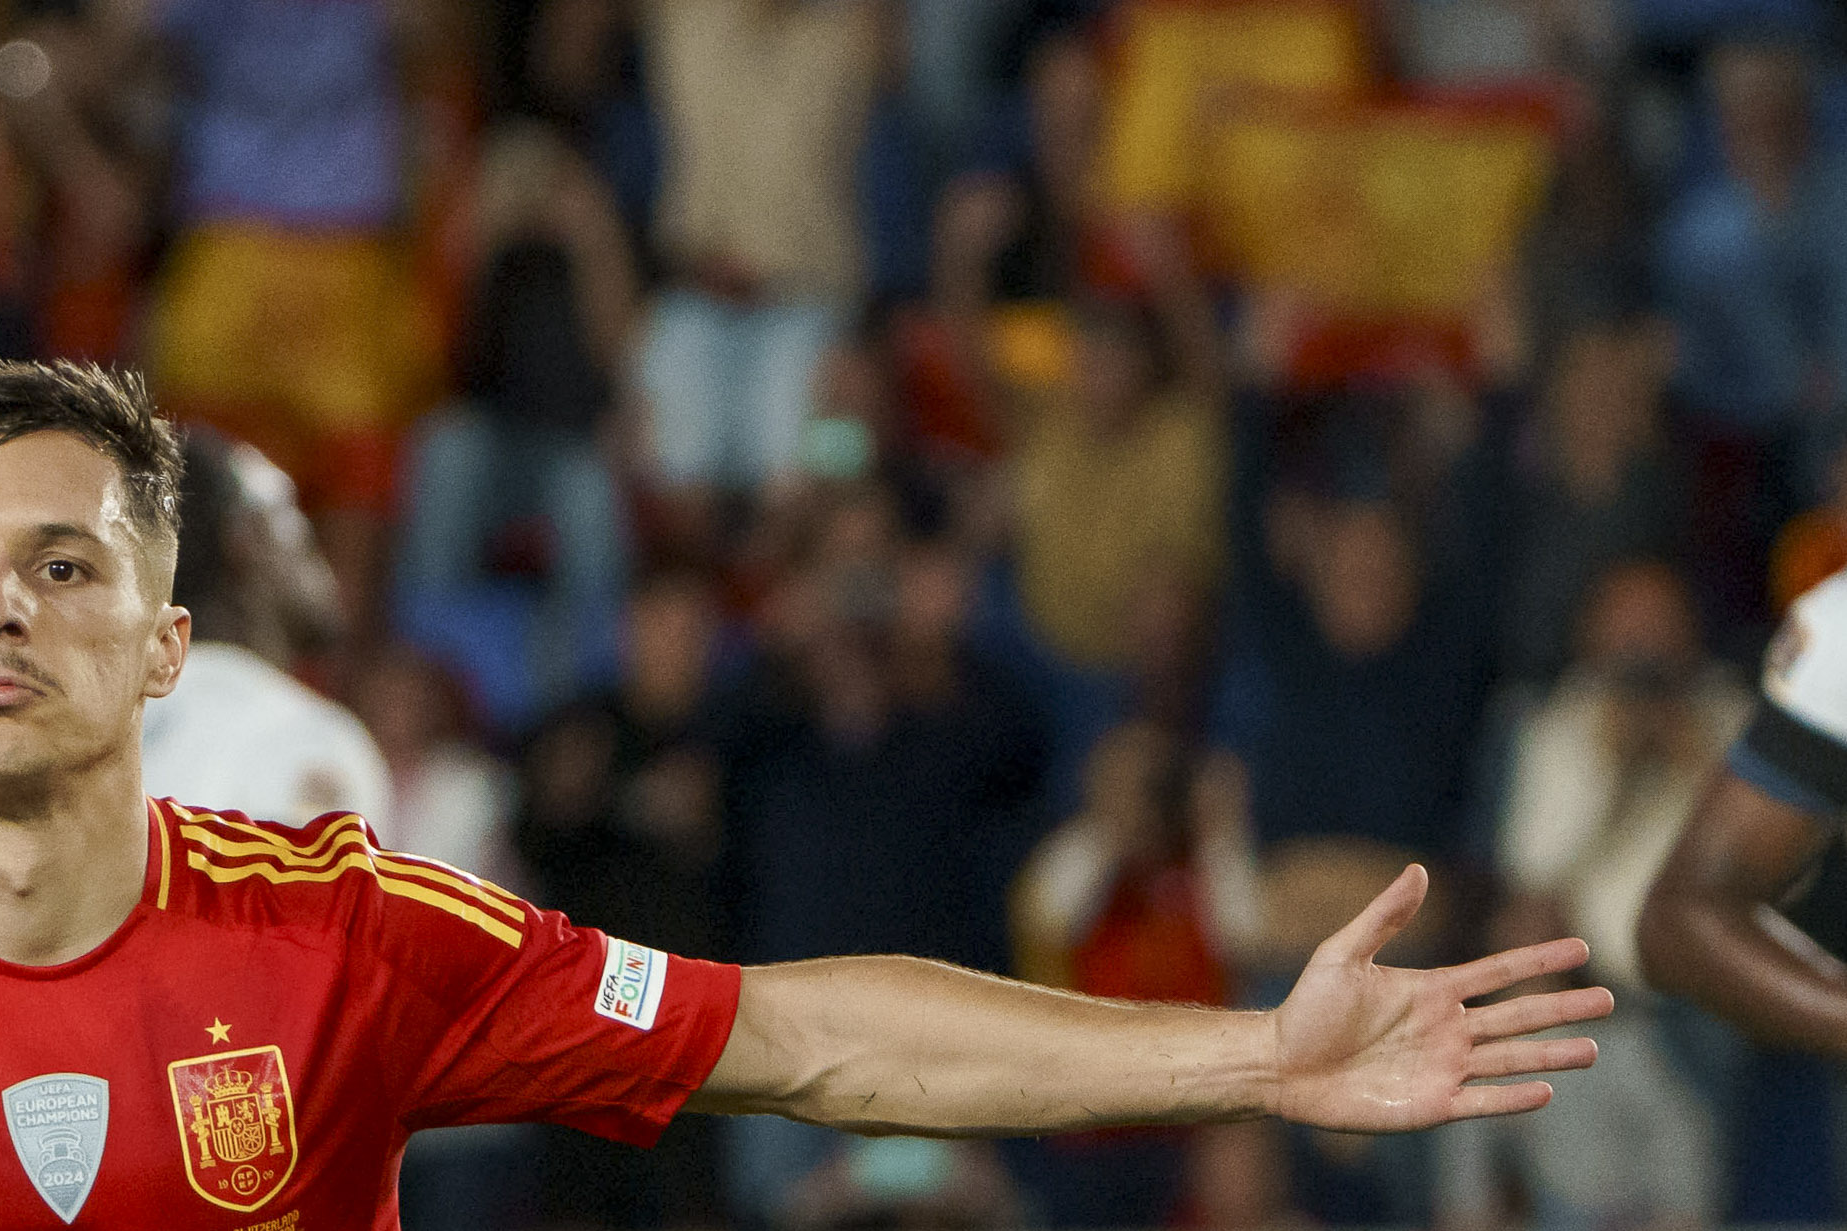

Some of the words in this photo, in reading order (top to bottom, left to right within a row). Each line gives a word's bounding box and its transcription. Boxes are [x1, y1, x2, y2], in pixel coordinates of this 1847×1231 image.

[600, 974, 620, 1011] UEFA
[40, 1083, 72, 1095] UEFA
[15, 1093, 98, 1113] EUROPEAN
[17, 1108, 99, 1127] CHAMPIONS
[43, 1170, 85, 1187] 2024
